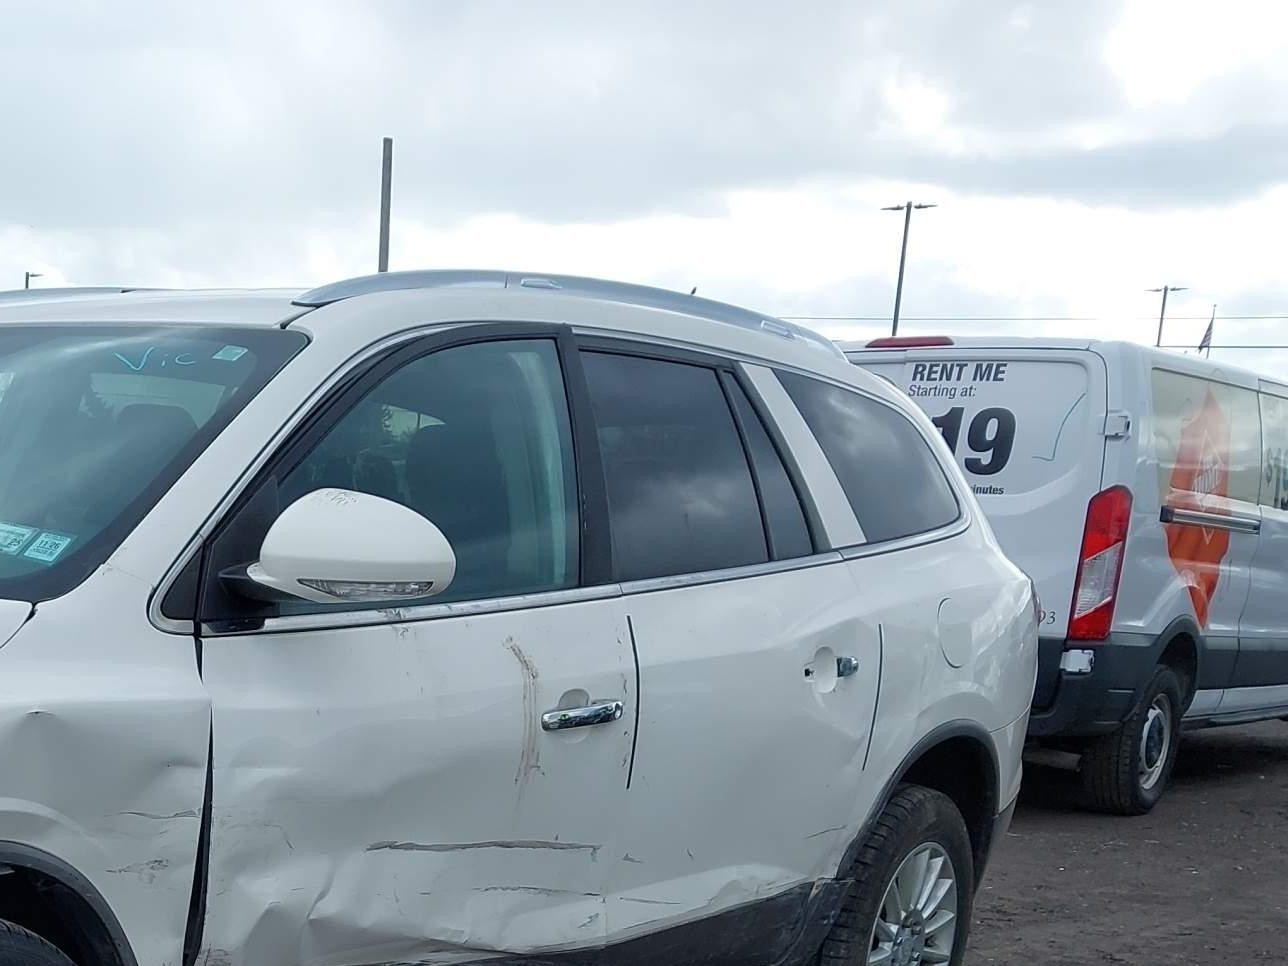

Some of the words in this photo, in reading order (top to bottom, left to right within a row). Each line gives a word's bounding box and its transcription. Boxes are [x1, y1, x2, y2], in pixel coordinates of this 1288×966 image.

[912, 363, 968, 382] RENT
[972, 363, 1008, 382] ME
[908, 385, 957, 399] Starting
[960, 386, 976, 397] at:
[970, 484, 1005, 495] inutes
